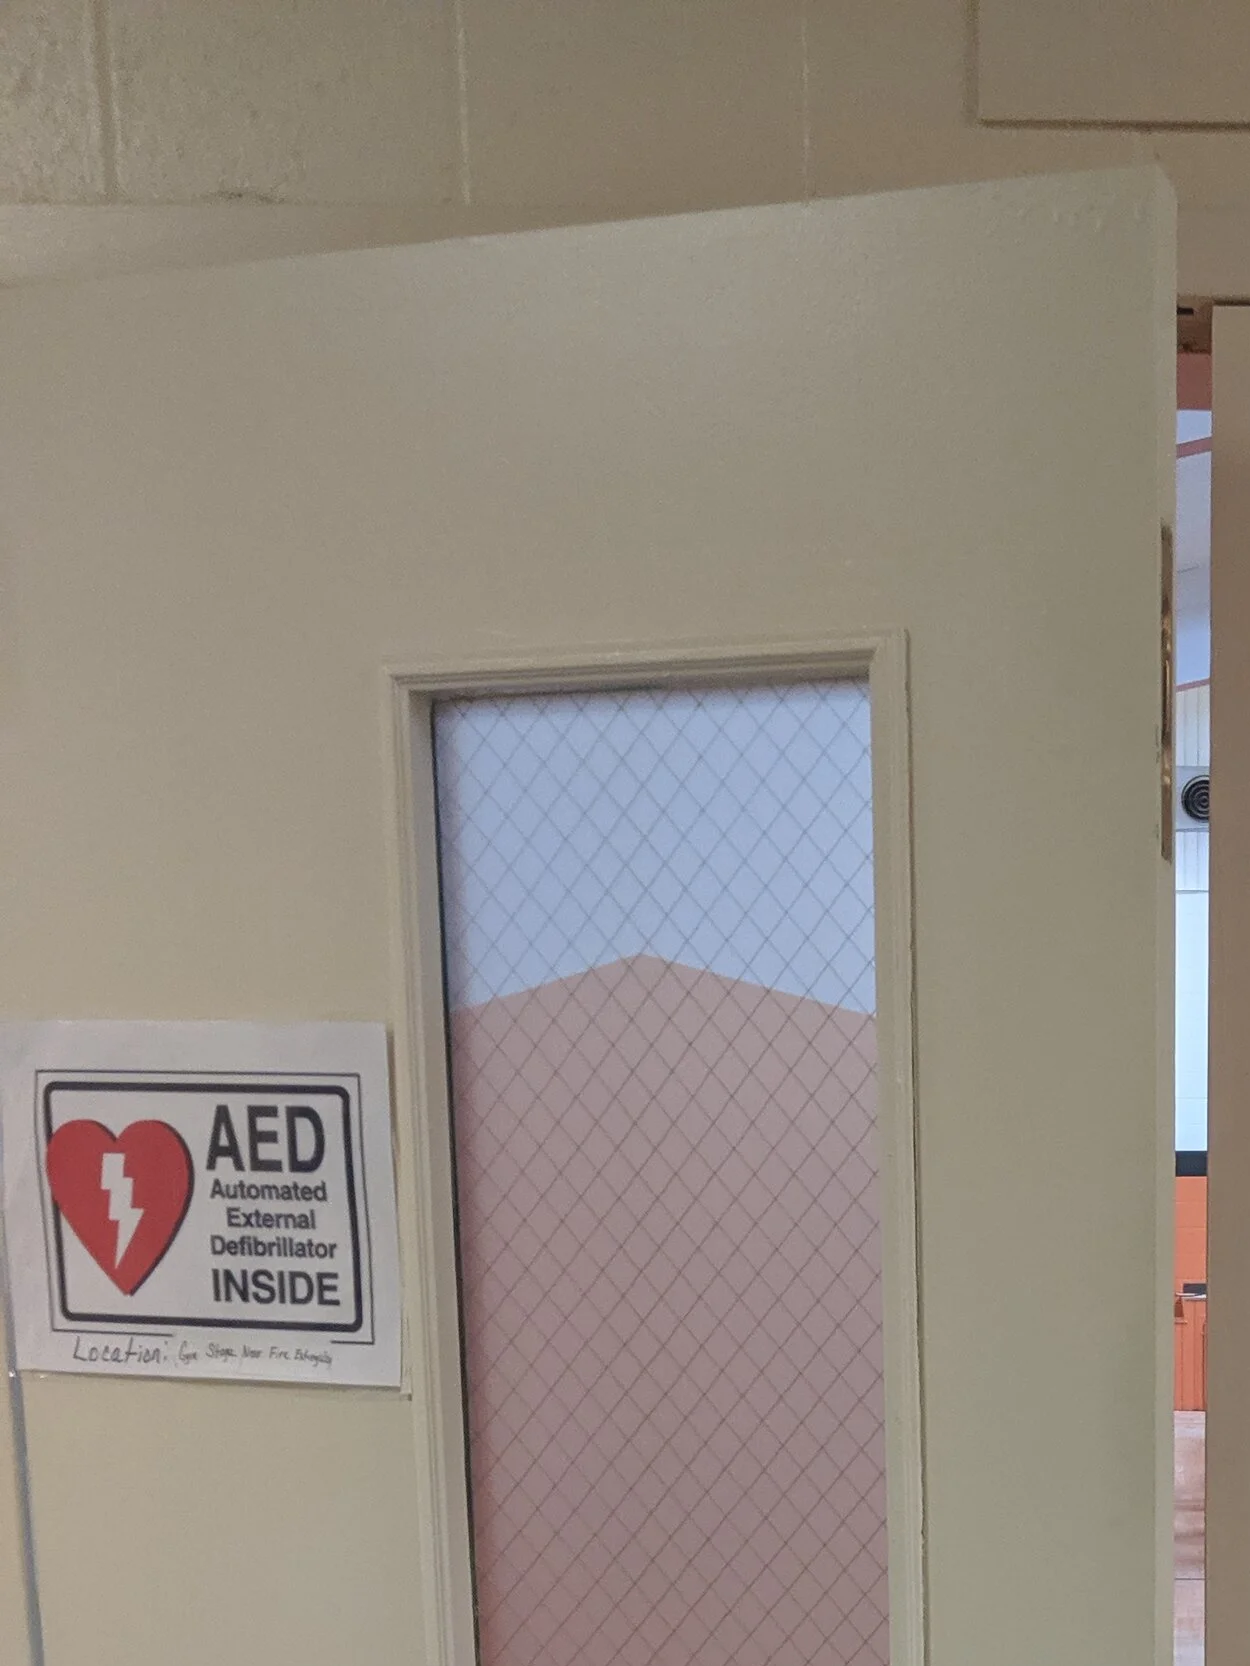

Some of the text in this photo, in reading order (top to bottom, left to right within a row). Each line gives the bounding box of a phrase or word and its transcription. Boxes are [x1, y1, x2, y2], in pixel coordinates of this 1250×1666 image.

[206, 1105, 325, 1173] AED
[210, 1179, 327, 1202] Automated
[227, 1207, 316, 1230] External
[210, 1235, 338, 1259] Defibrillator
[211, 1268, 341, 1306] INSIDE
[73, 1335, 169, 1364] Location:
